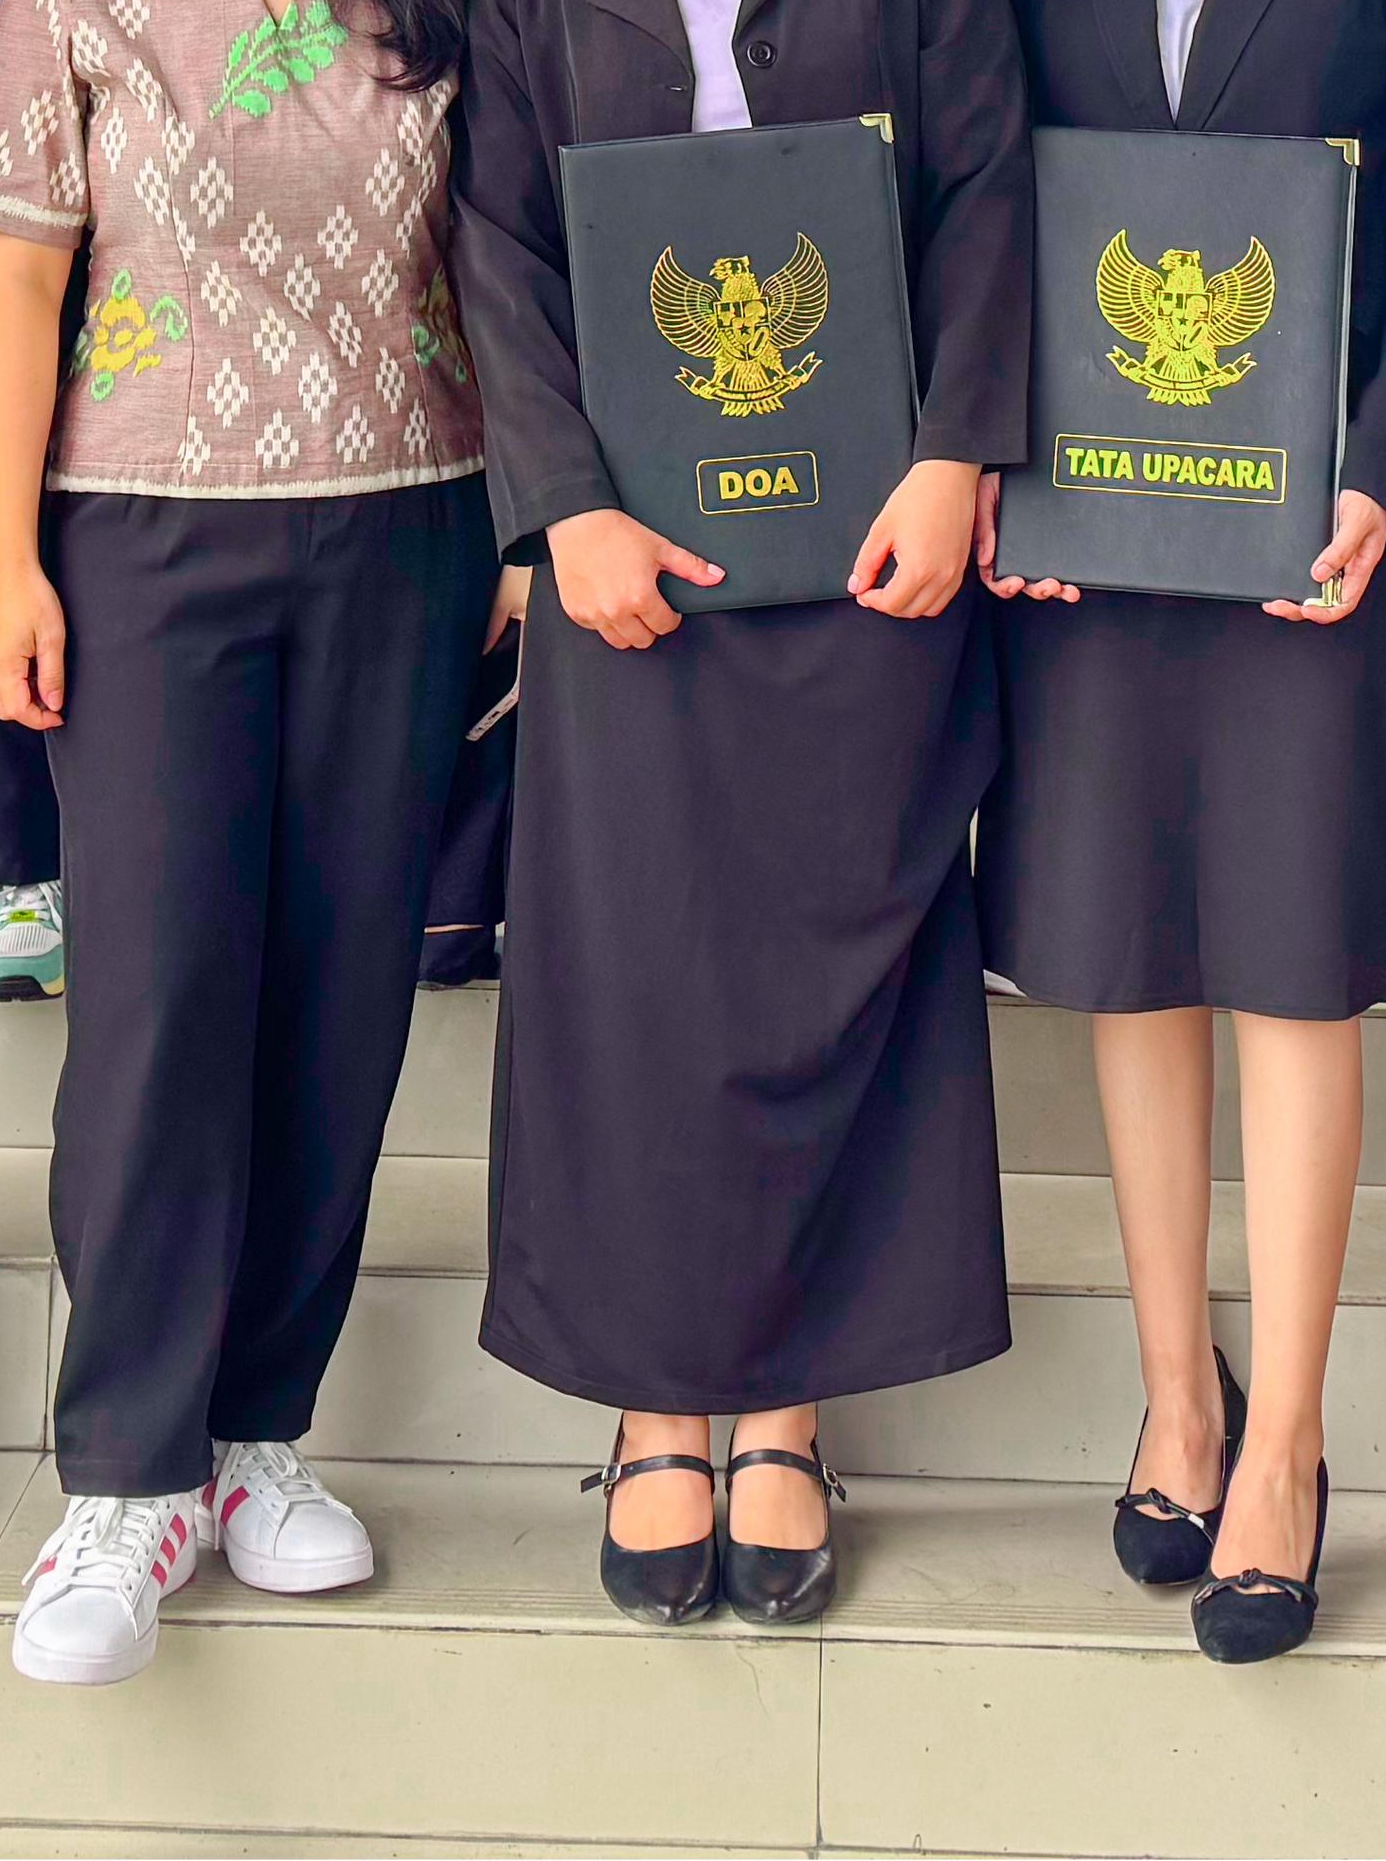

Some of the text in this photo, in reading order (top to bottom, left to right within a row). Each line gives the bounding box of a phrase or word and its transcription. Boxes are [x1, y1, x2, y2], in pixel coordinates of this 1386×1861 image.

[718, 466, 800, 501] DOA
[1065, 447, 1275, 491] TATA UPACARA
